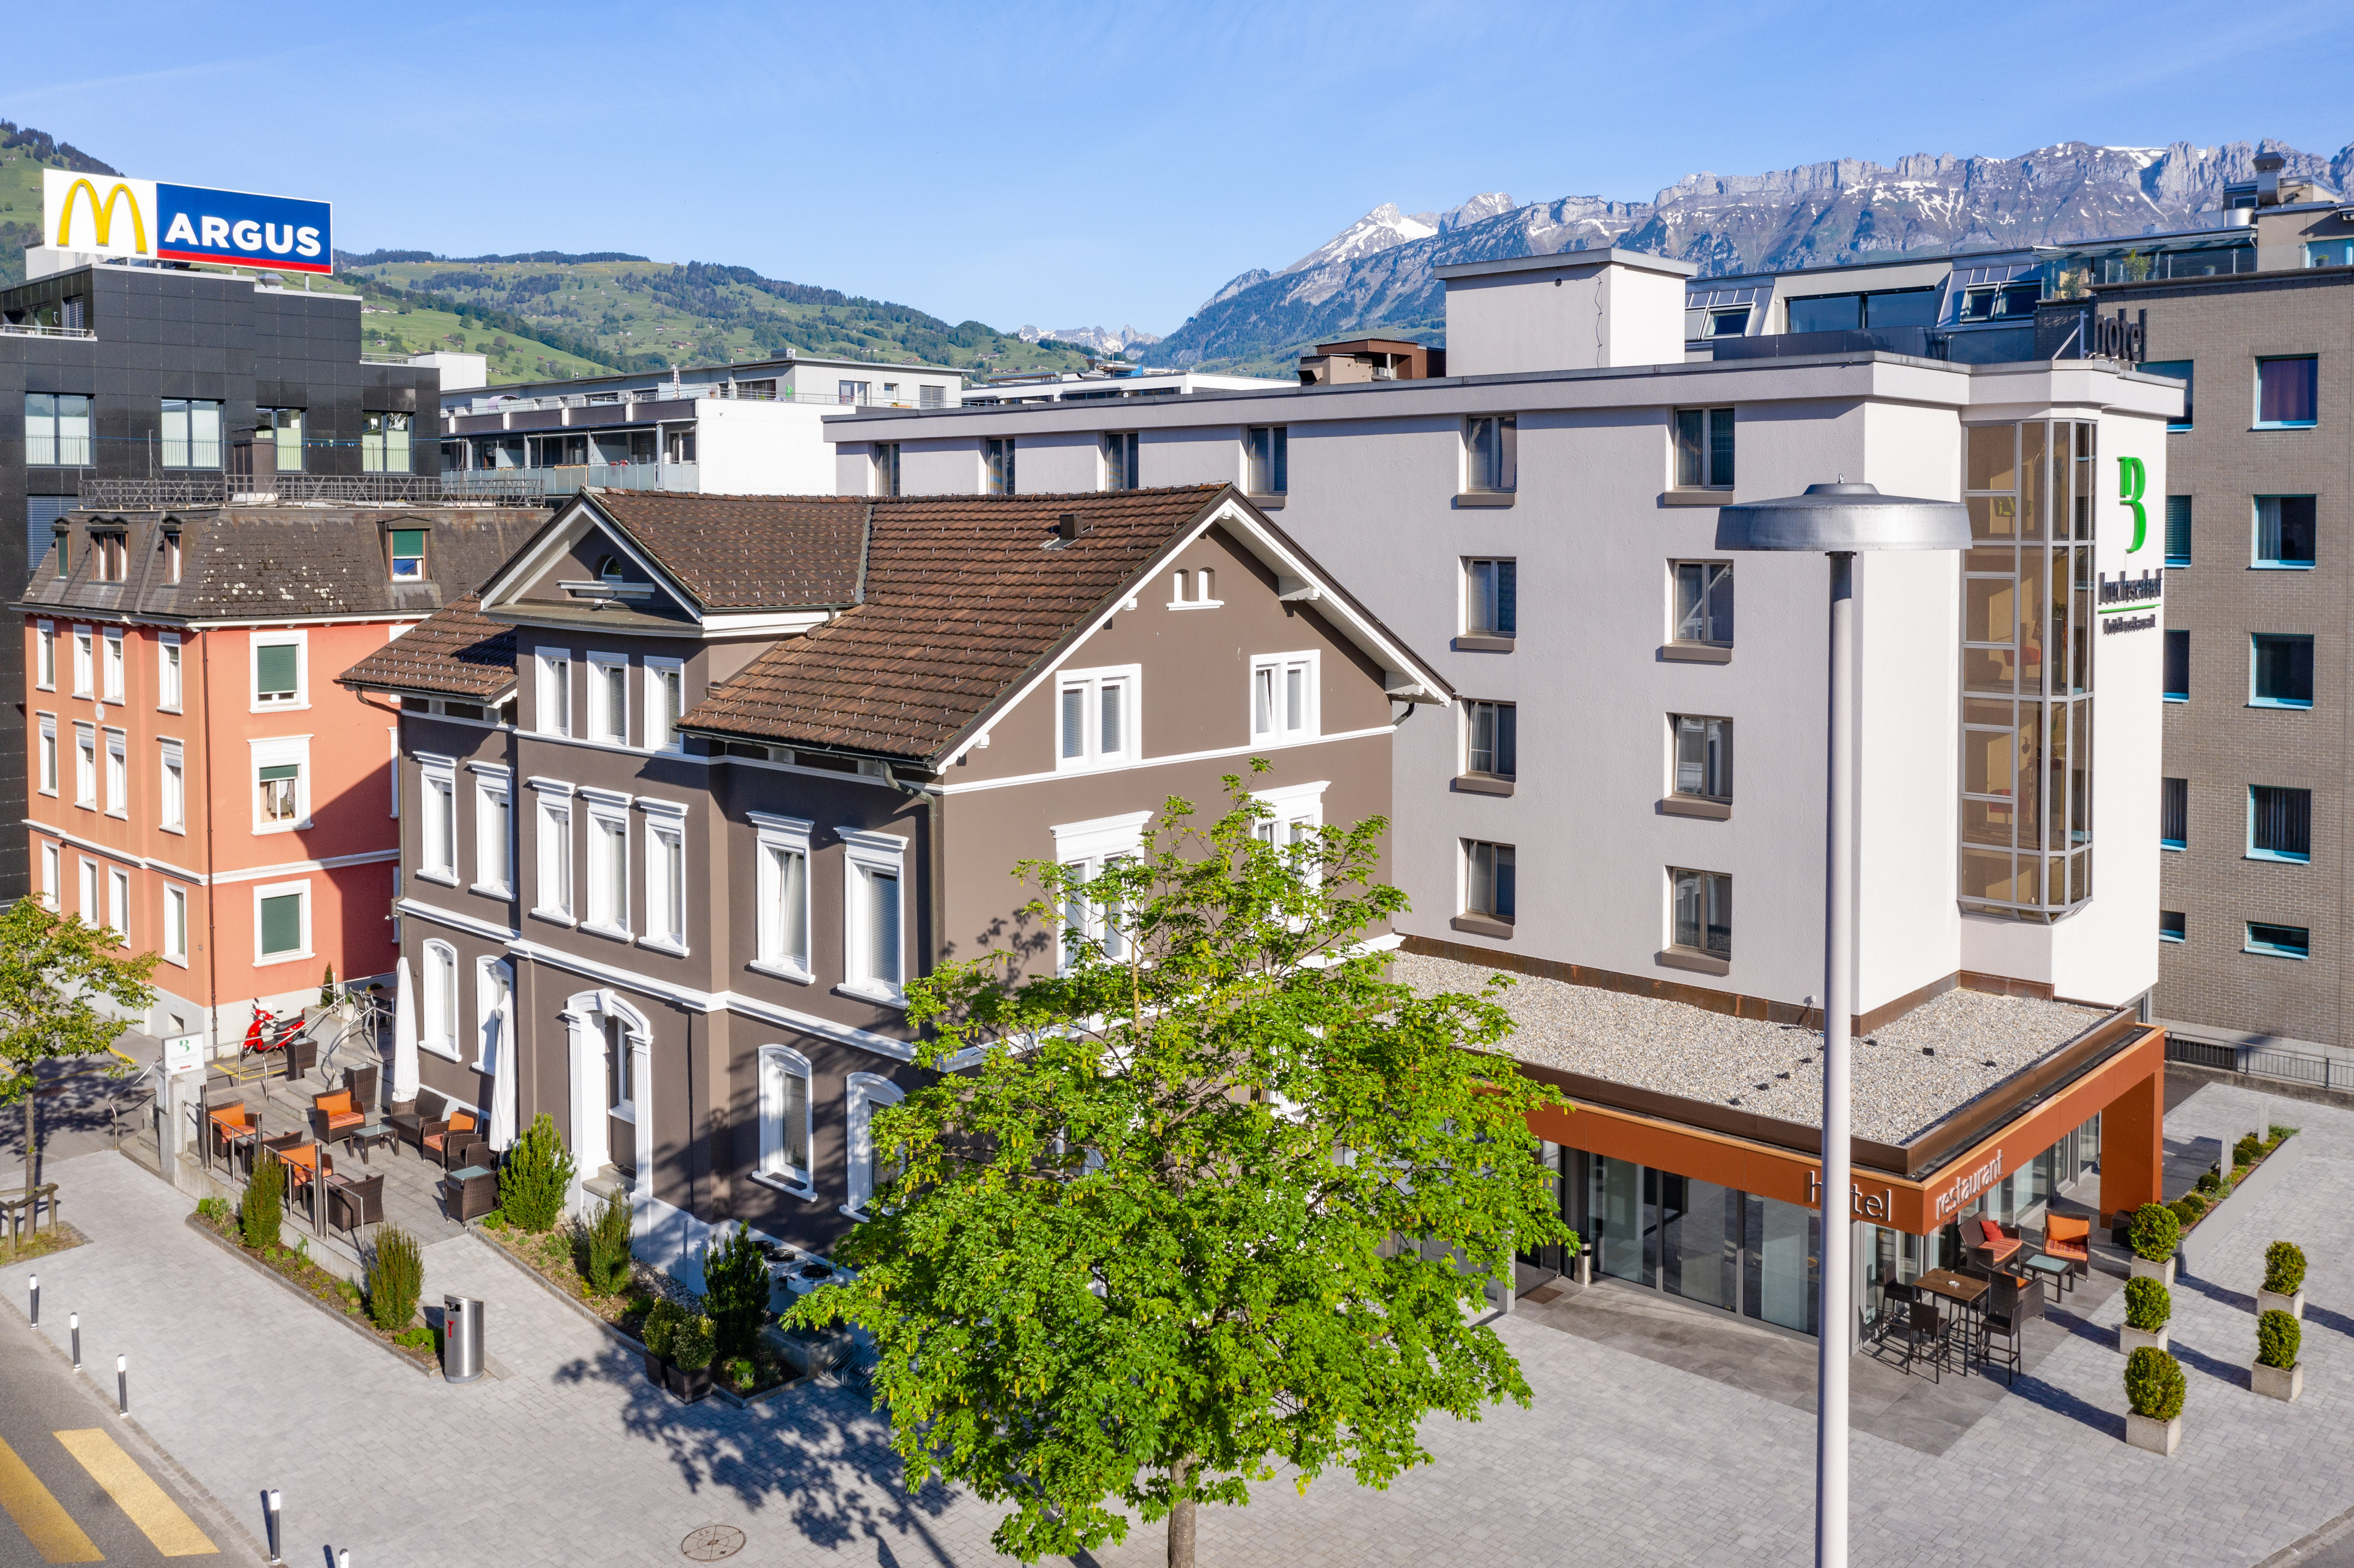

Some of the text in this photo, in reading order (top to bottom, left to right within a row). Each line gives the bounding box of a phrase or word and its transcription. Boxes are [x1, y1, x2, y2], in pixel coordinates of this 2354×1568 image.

[165, 213, 321, 257] ARGUS
[2094, 295, 2147, 363] hotel
[171, 1052, 198, 1061] buchserhof
[1809, 1171, 1891, 1222] htel
[1936, 1149, 2003, 1220] restaurant
